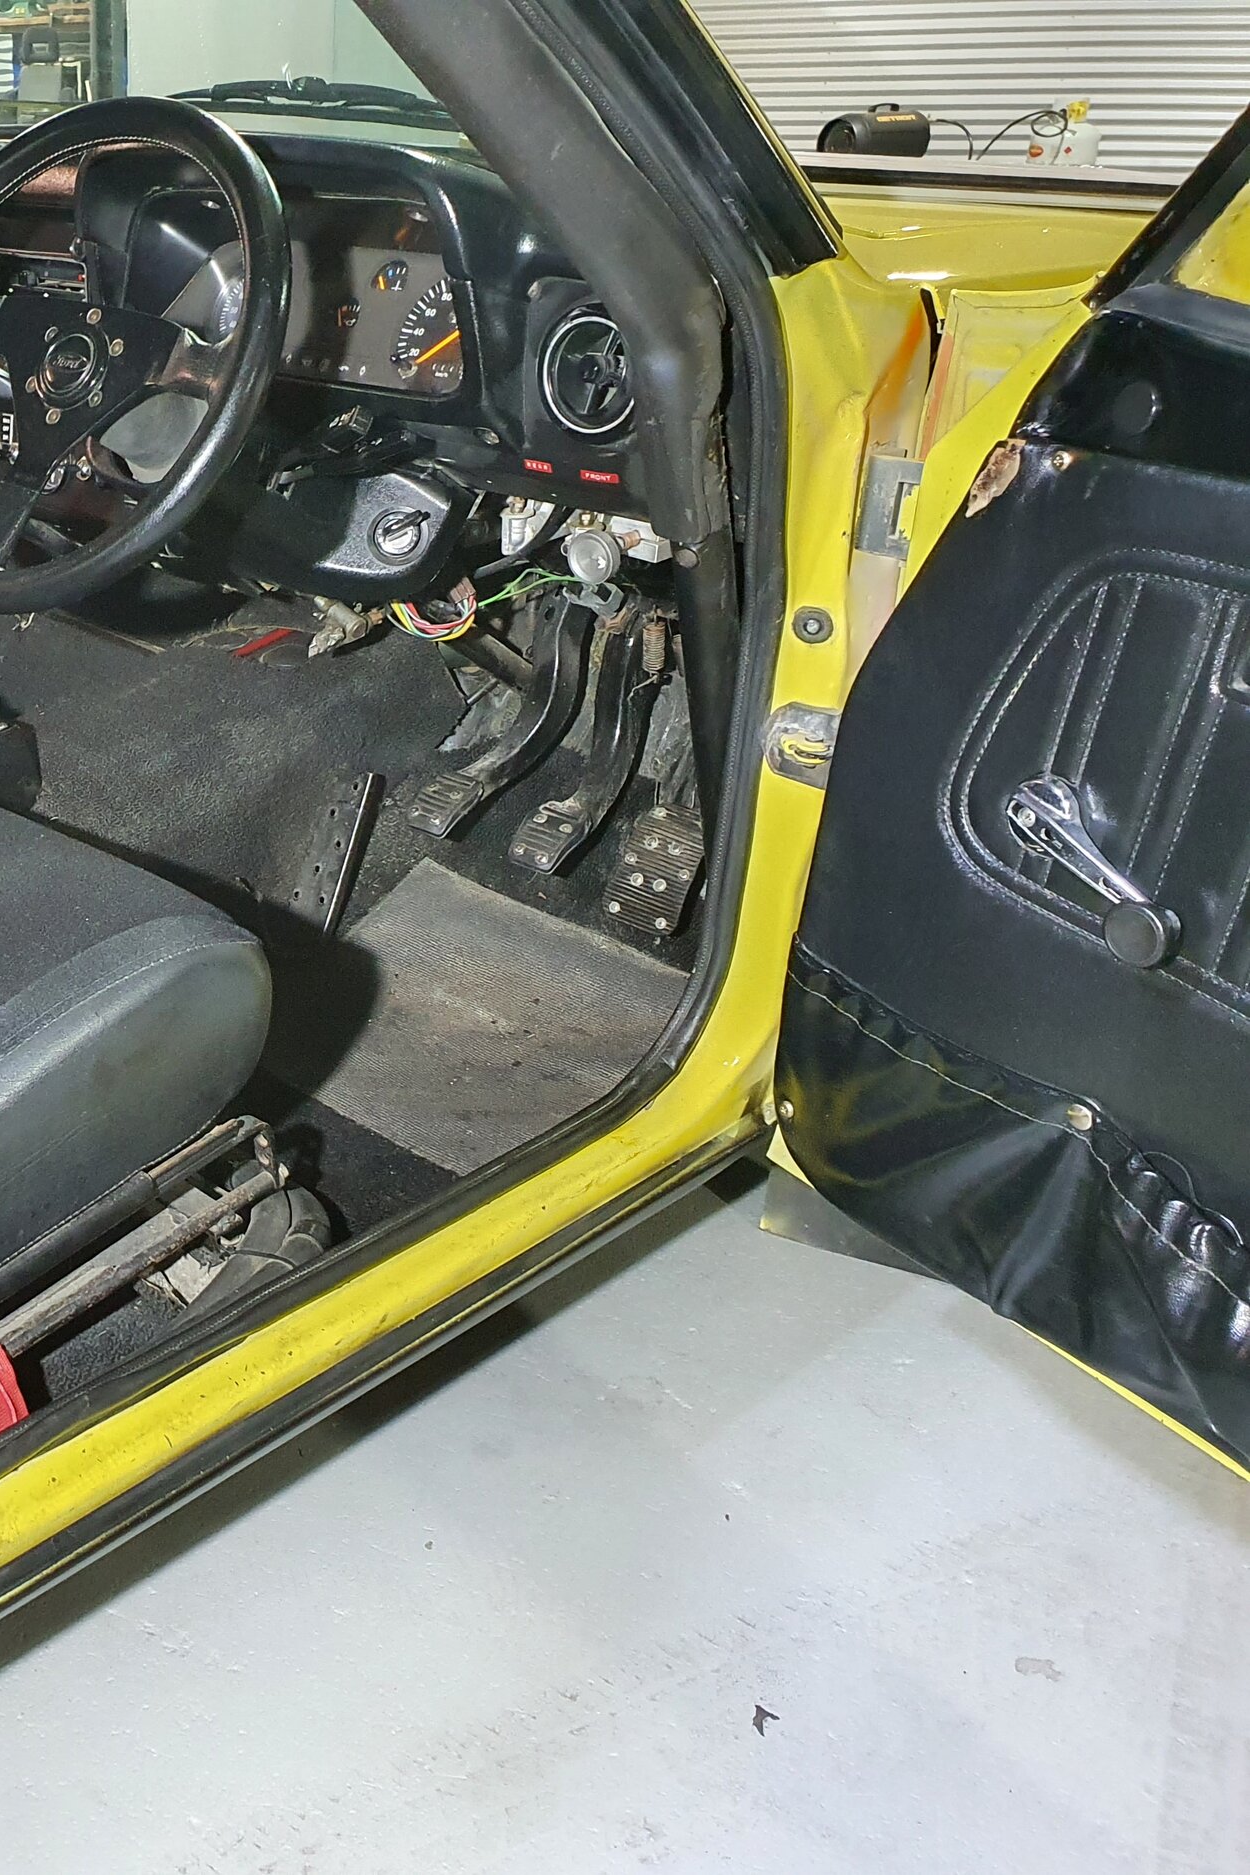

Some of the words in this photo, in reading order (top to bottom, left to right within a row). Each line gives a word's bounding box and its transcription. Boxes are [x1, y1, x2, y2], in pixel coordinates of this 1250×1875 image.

[441, 292, 452, 301] 80
[425, 308, 437, 317] 60
[413, 328, 425, 336] 40
[409, 348, 420, 356] 20
[585, 473, 611, 481] FRONT
